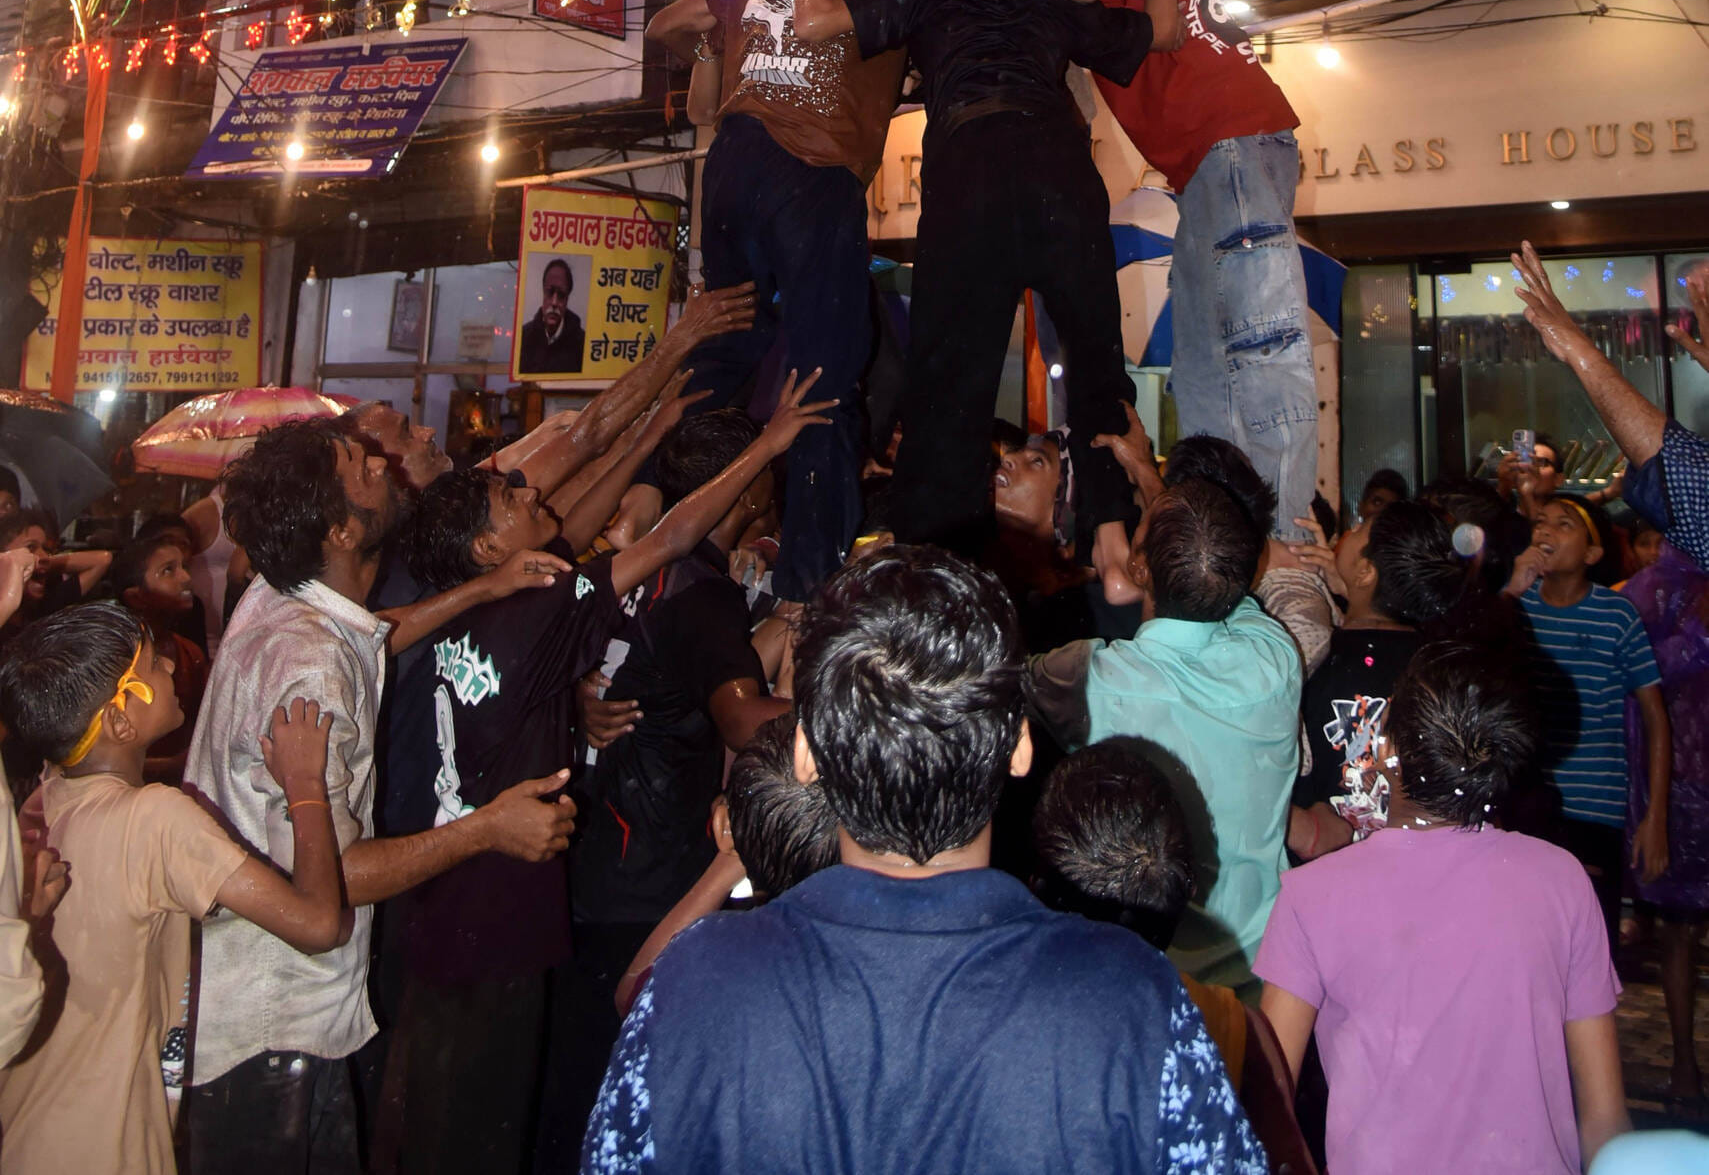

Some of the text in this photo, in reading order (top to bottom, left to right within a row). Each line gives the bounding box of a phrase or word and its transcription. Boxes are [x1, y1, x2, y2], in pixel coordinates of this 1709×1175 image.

[1298, 117, 1698, 183] LASS HOUSE
[529, 210, 604, 249] अग्रवाल
[147, 247, 206, 273] मशीन
[83, 276, 125, 301] टील
[168, 284, 221, 301] वाशर
[598, 268, 627, 287] अब
[606, 294, 649, 323] शिफ्ट
[83, 319, 137, 338] प्रकार
[139, 314, 159, 337] के
[164, 319, 233, 337] उपलब्ध
[236, 313, 252, 337] है
[77, 350, 138, 366] ग्रवाल
[590, 332, 609, 361] हो
[612, 332, 642, 362] गई
